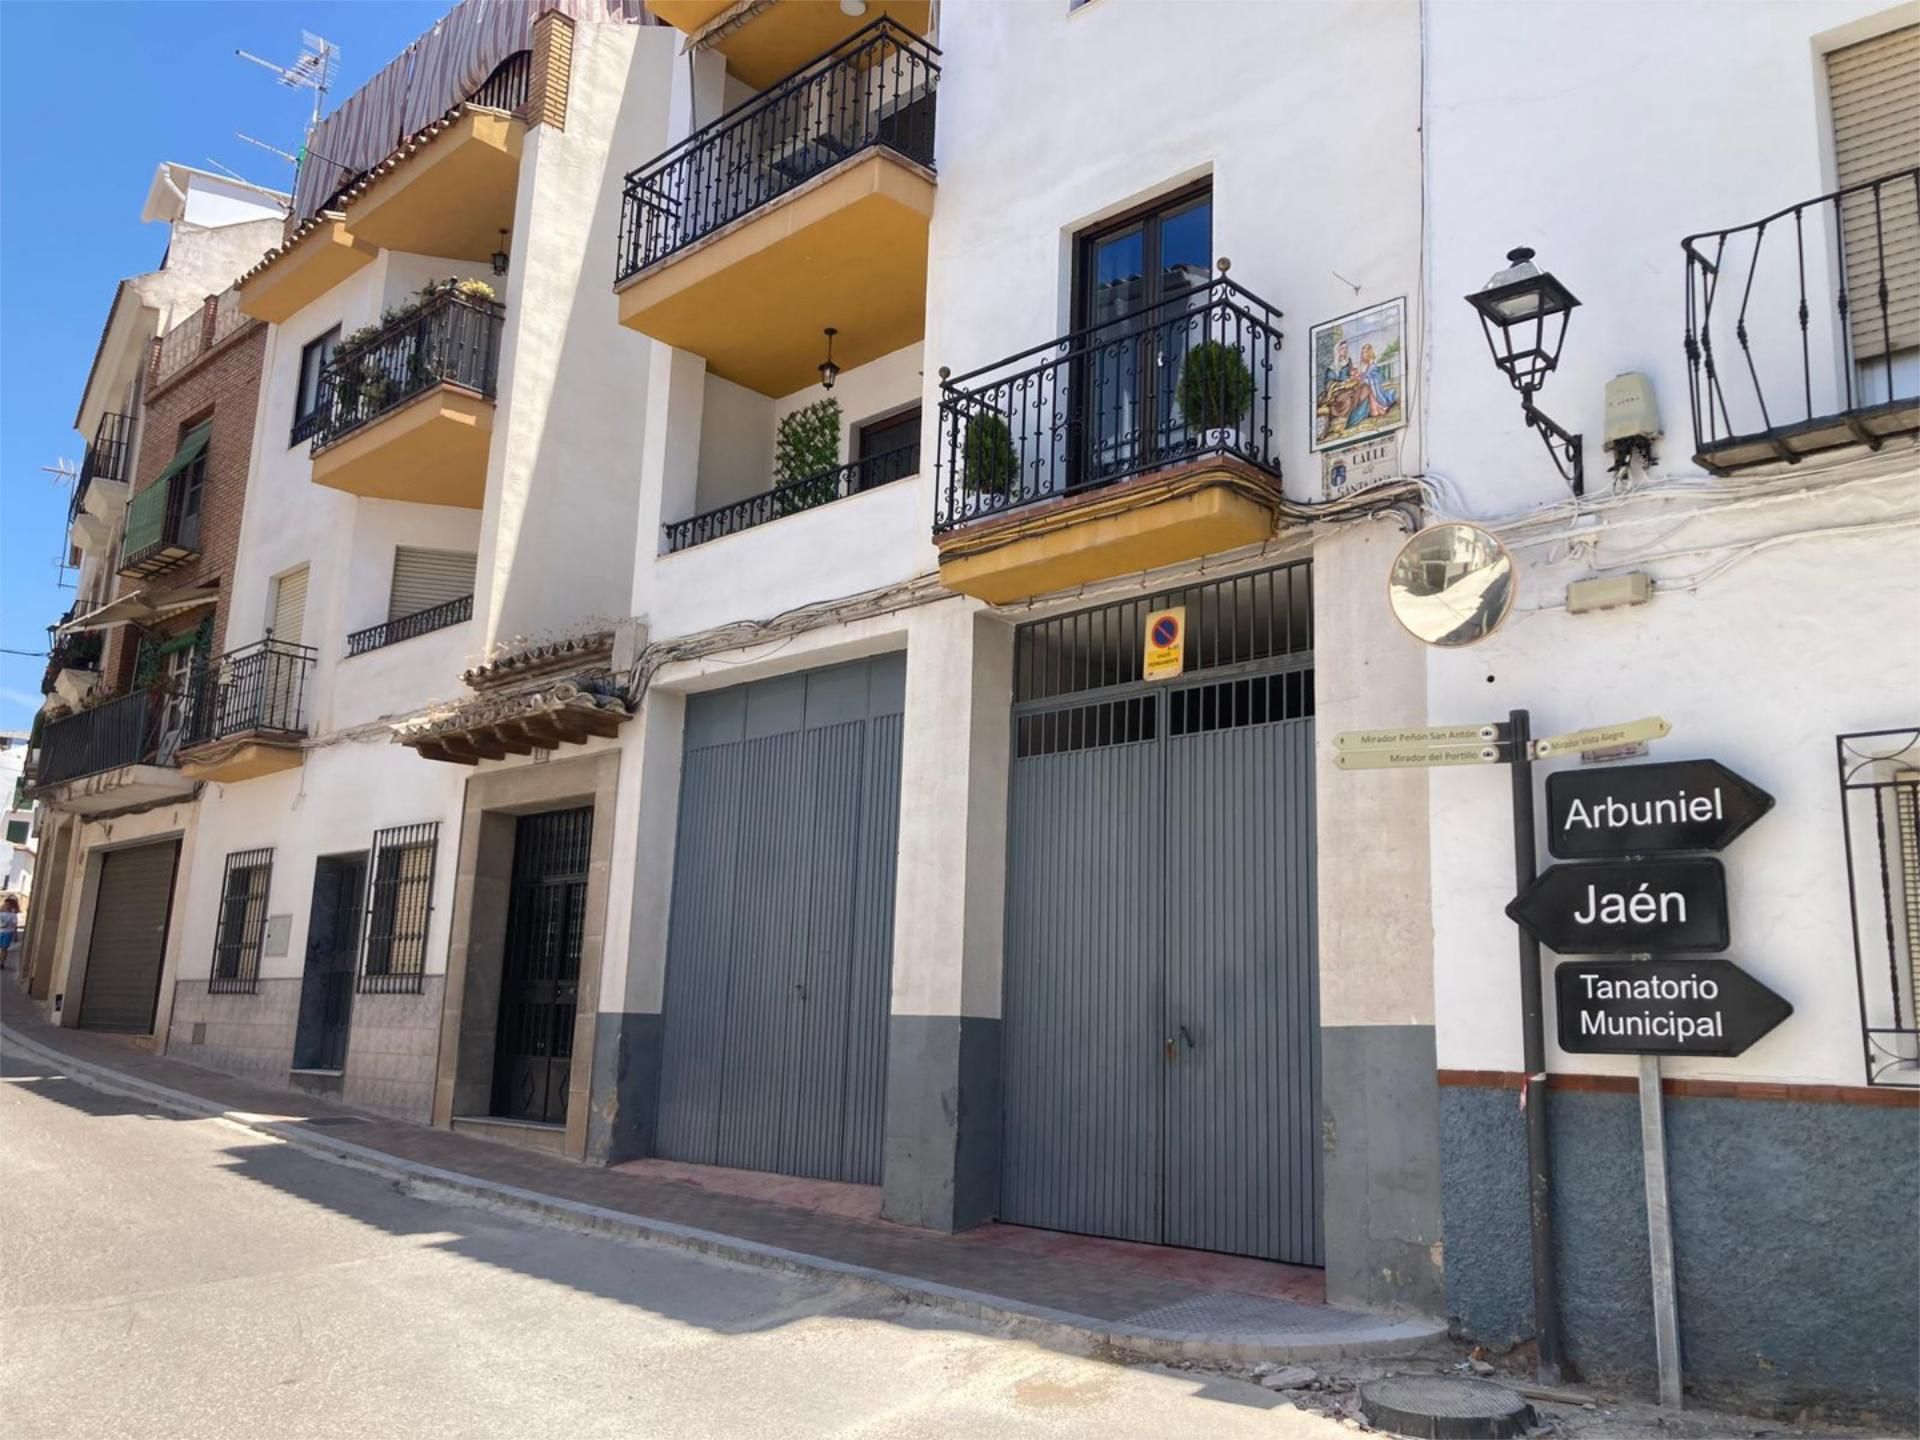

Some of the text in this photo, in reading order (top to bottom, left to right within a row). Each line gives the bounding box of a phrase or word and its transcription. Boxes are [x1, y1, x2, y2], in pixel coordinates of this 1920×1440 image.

[1353, 447, 1385, 465] CALLE
[1361, 730, 1477, 744] Mirador Peñón San Antón
[1390, 750, 1479, 763] Mirador del Portillo
[1564, 788, 1723, 830] Arbuniel
[1574, 882, 1687, 924] Jaén
[1579, 974, 1719, 999] Tanatorio
[1580, 1010, 1723, 1043] Municipal
